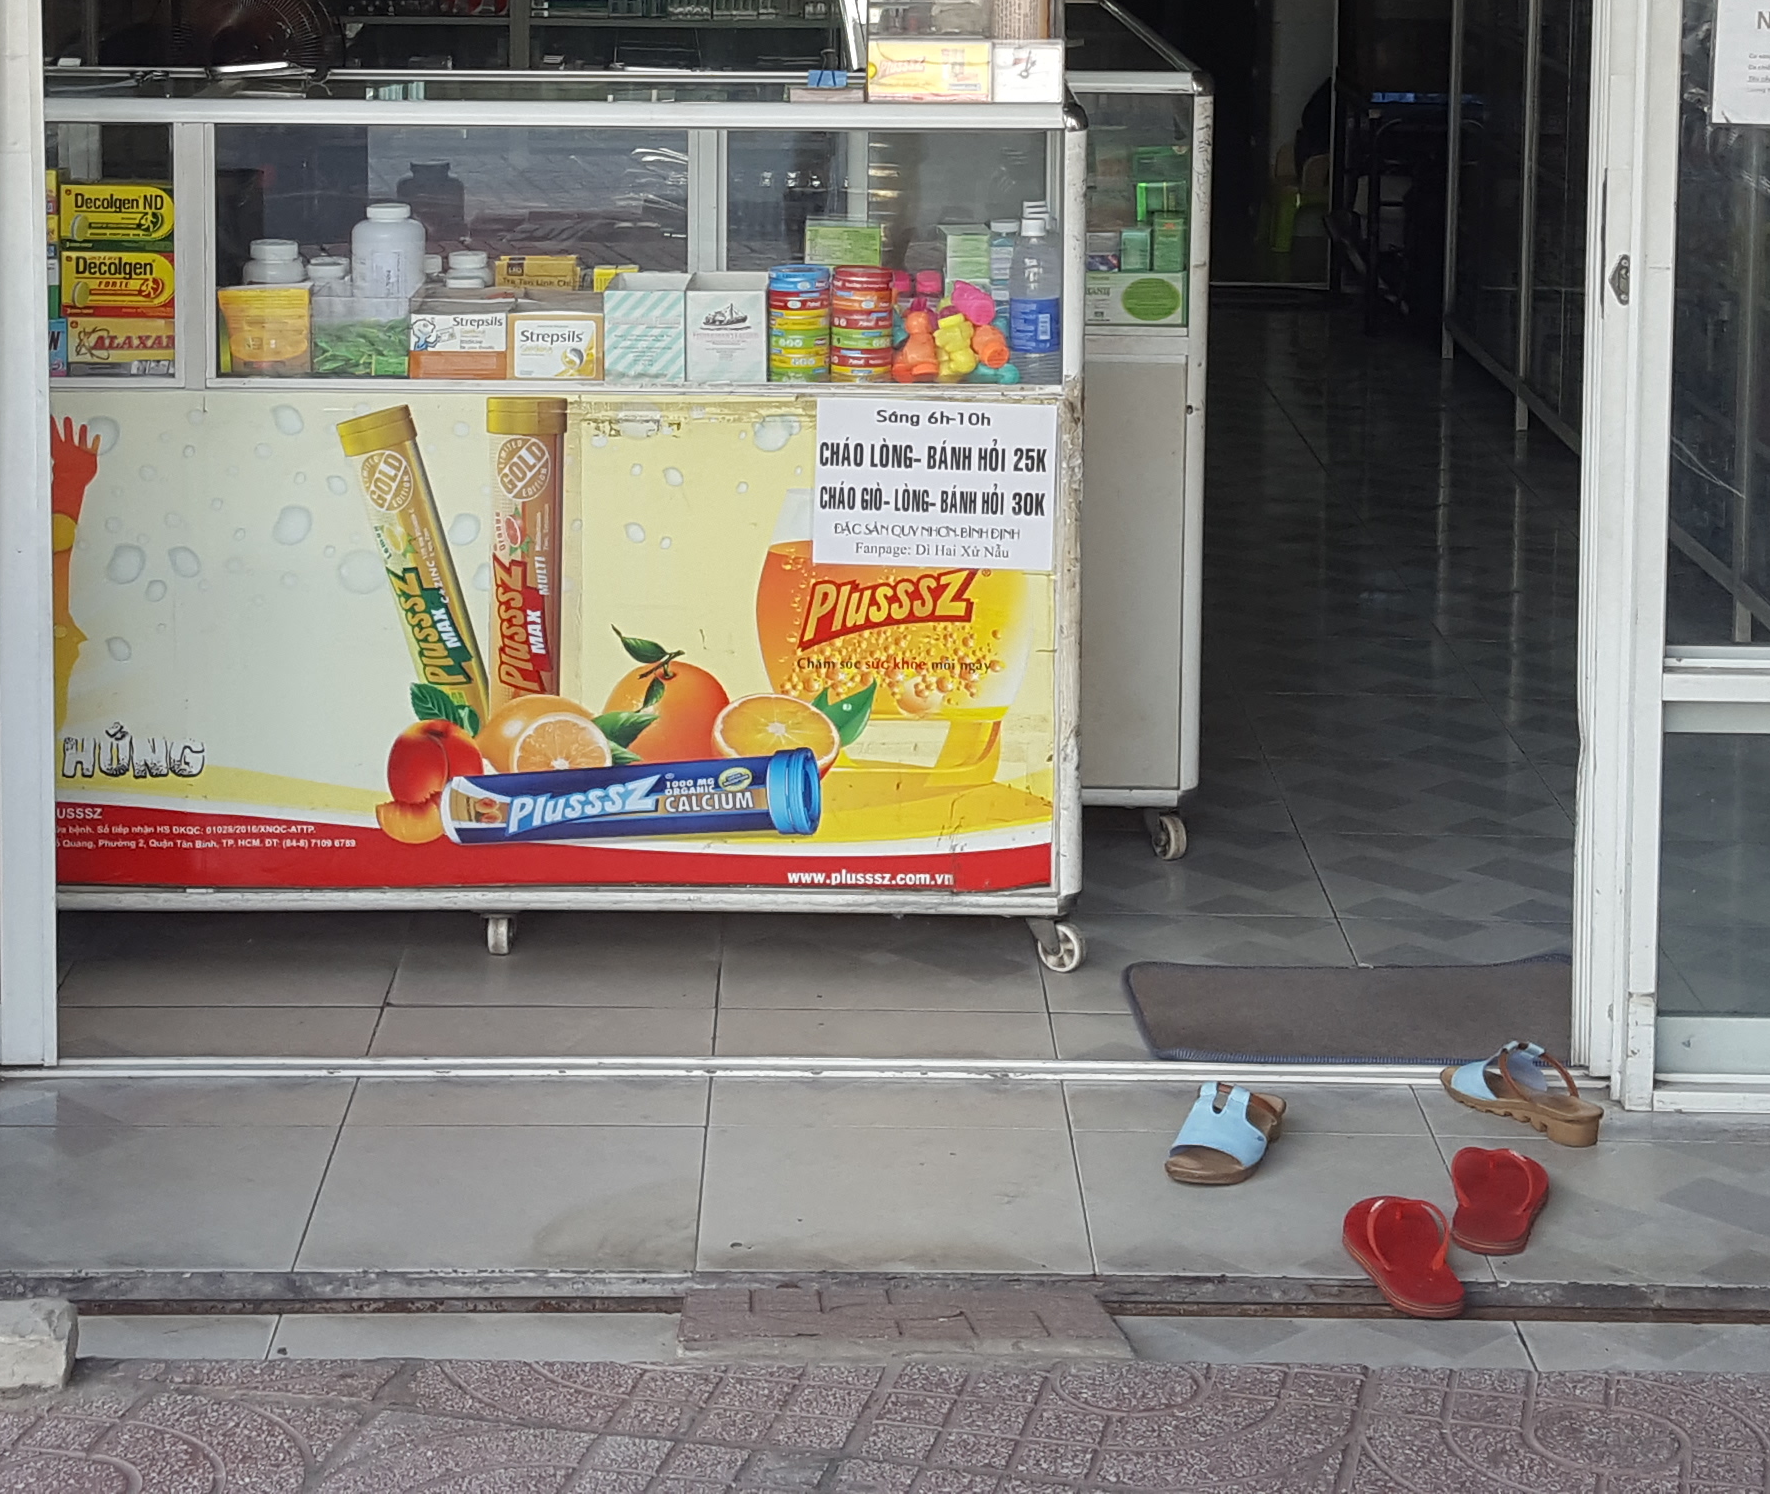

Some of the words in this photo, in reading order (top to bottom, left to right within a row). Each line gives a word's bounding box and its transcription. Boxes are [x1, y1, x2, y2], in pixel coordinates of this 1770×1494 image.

[75, 193, 139, 213] Decolgen
[143, 195, 164, 210] ND
[75, 256, 153, 279] Decolgen
[453, 317, 503, 328] Strepsils
[520, 329, 582, 344] Strepsils
[876, 410, 920, 426] Sáng
[928, 411, 991, 426] 6h-10h
[819, 437, 864, 467] CHÁO
[870, 438, 921, 469] LÒNG-
[927, 440, 972, 471] BÁNH
[978, 439, 1005, 472] HỎI
[1013, 448, 1047, 473] 25K
[502, 439, 548, 493] GOLD
[369, 454, 405, 505] GOLD
[819, 481, 856, 510] CHÁO
[940, 485, 977, 515] BÁNH
[981, 484, 1004, 515] HỎI
[1012, 492, 1045, 516] 30K
[834, 521, 861, 537] ĐẶC
[863, 521, 888, 535] SẢN
[891, 524, 919, 537] QUY
[990, 528, 1020, 542] ĐỊNH
[855, 542, 911, 557] Fanpage:
[935, 544, 956, 556] Hai
[534, 556, 550, 596] MULTI
[431, 607, 462, 649] MAX
[527, 609, 547, 654] MAX
[797, 657, 835, 670] Chăm
[840, 657, 860, 670] sóc
[865, 658, 888, 670] sức
[960, 658, 991, 674] ngày
[665, 779, 694, 788] 1000
[696, 777, 715, 787] MG
[665, 785, 715, 795] ORGANIC
[665, 791, 754, 814] CALCIUM
[787, 869, 954, 887] www.plusssz.com.vn
